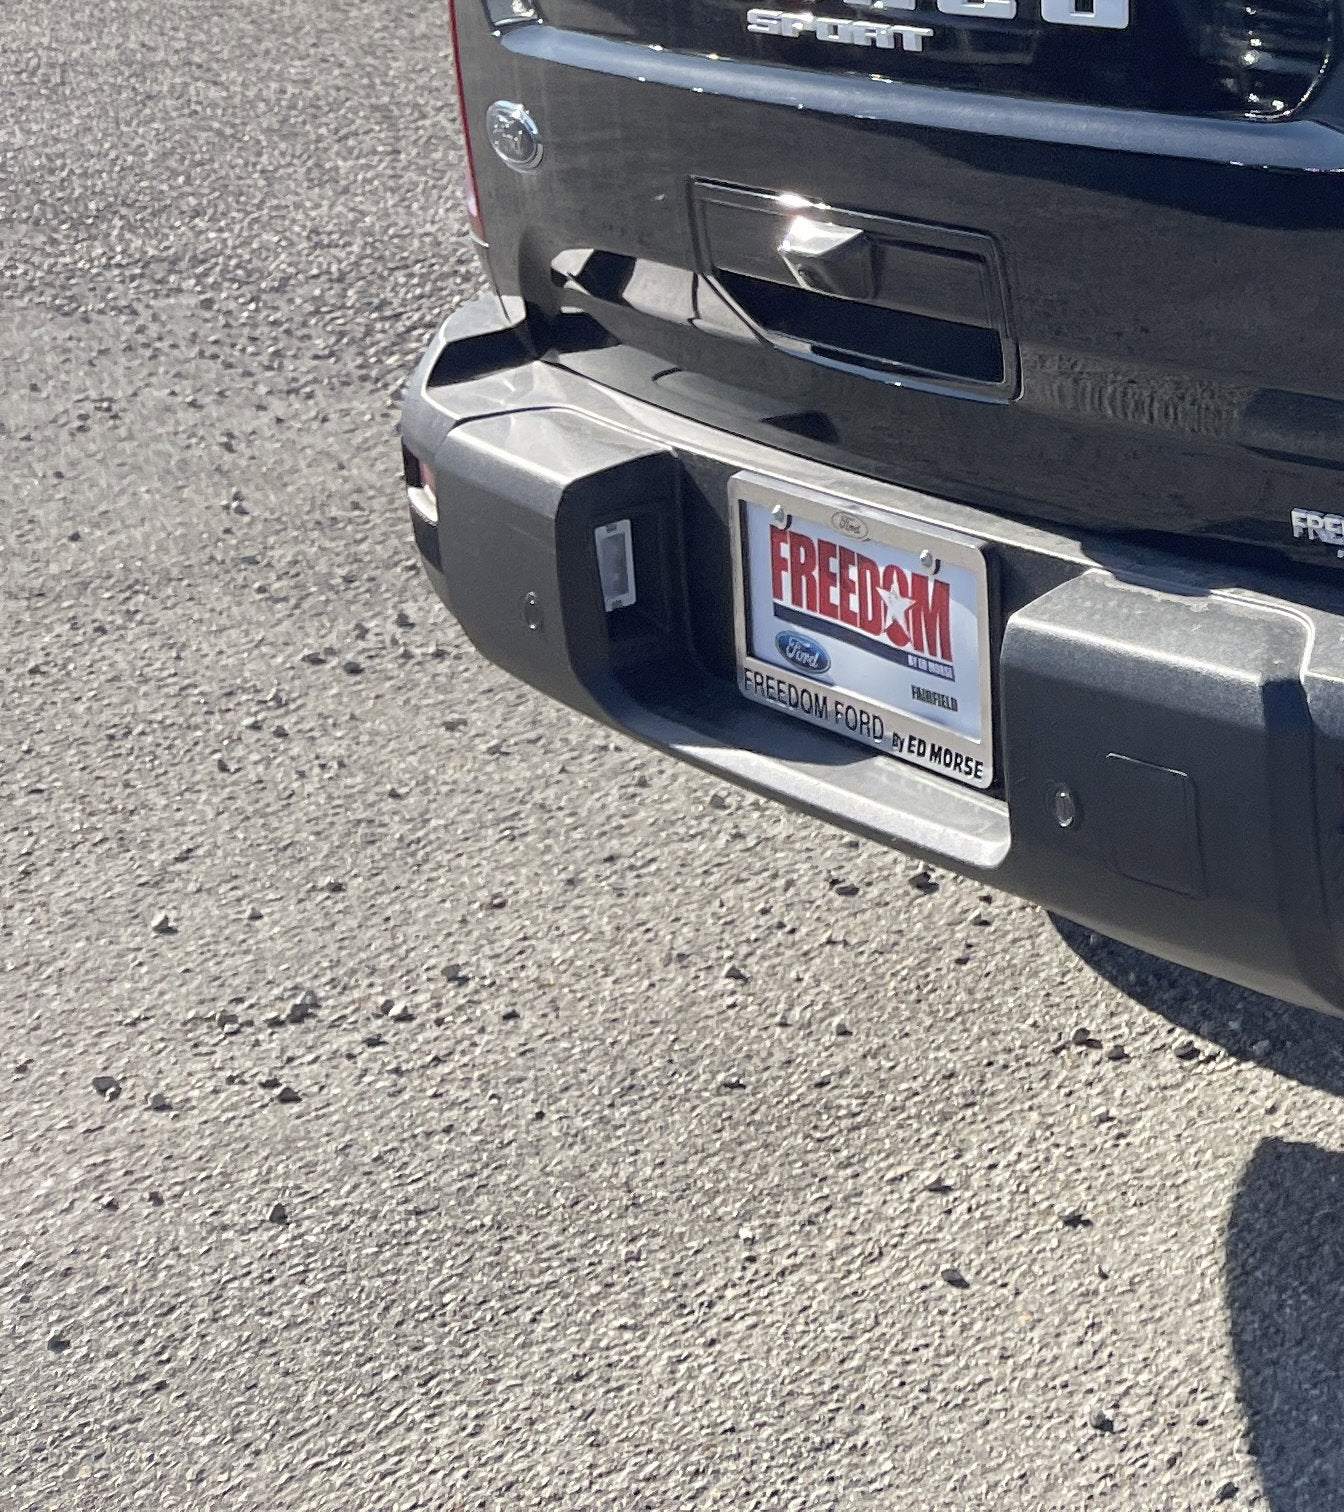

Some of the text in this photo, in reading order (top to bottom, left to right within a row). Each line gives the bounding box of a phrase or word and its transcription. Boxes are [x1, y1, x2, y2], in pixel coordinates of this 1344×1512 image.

[747, 7, 934, 52] SPORT
[769, 524, 953, 663] FREEDOM
[784, 636, 820, 669] Ford
[910, 684, 959, 712] FAIRFIELD
[743, 667, 830, 721] FREEDOM
[834, 699, 885, 741] FORD
[907, 735, 927, 758] ED
[928, 743, 985, 780] MORSE
